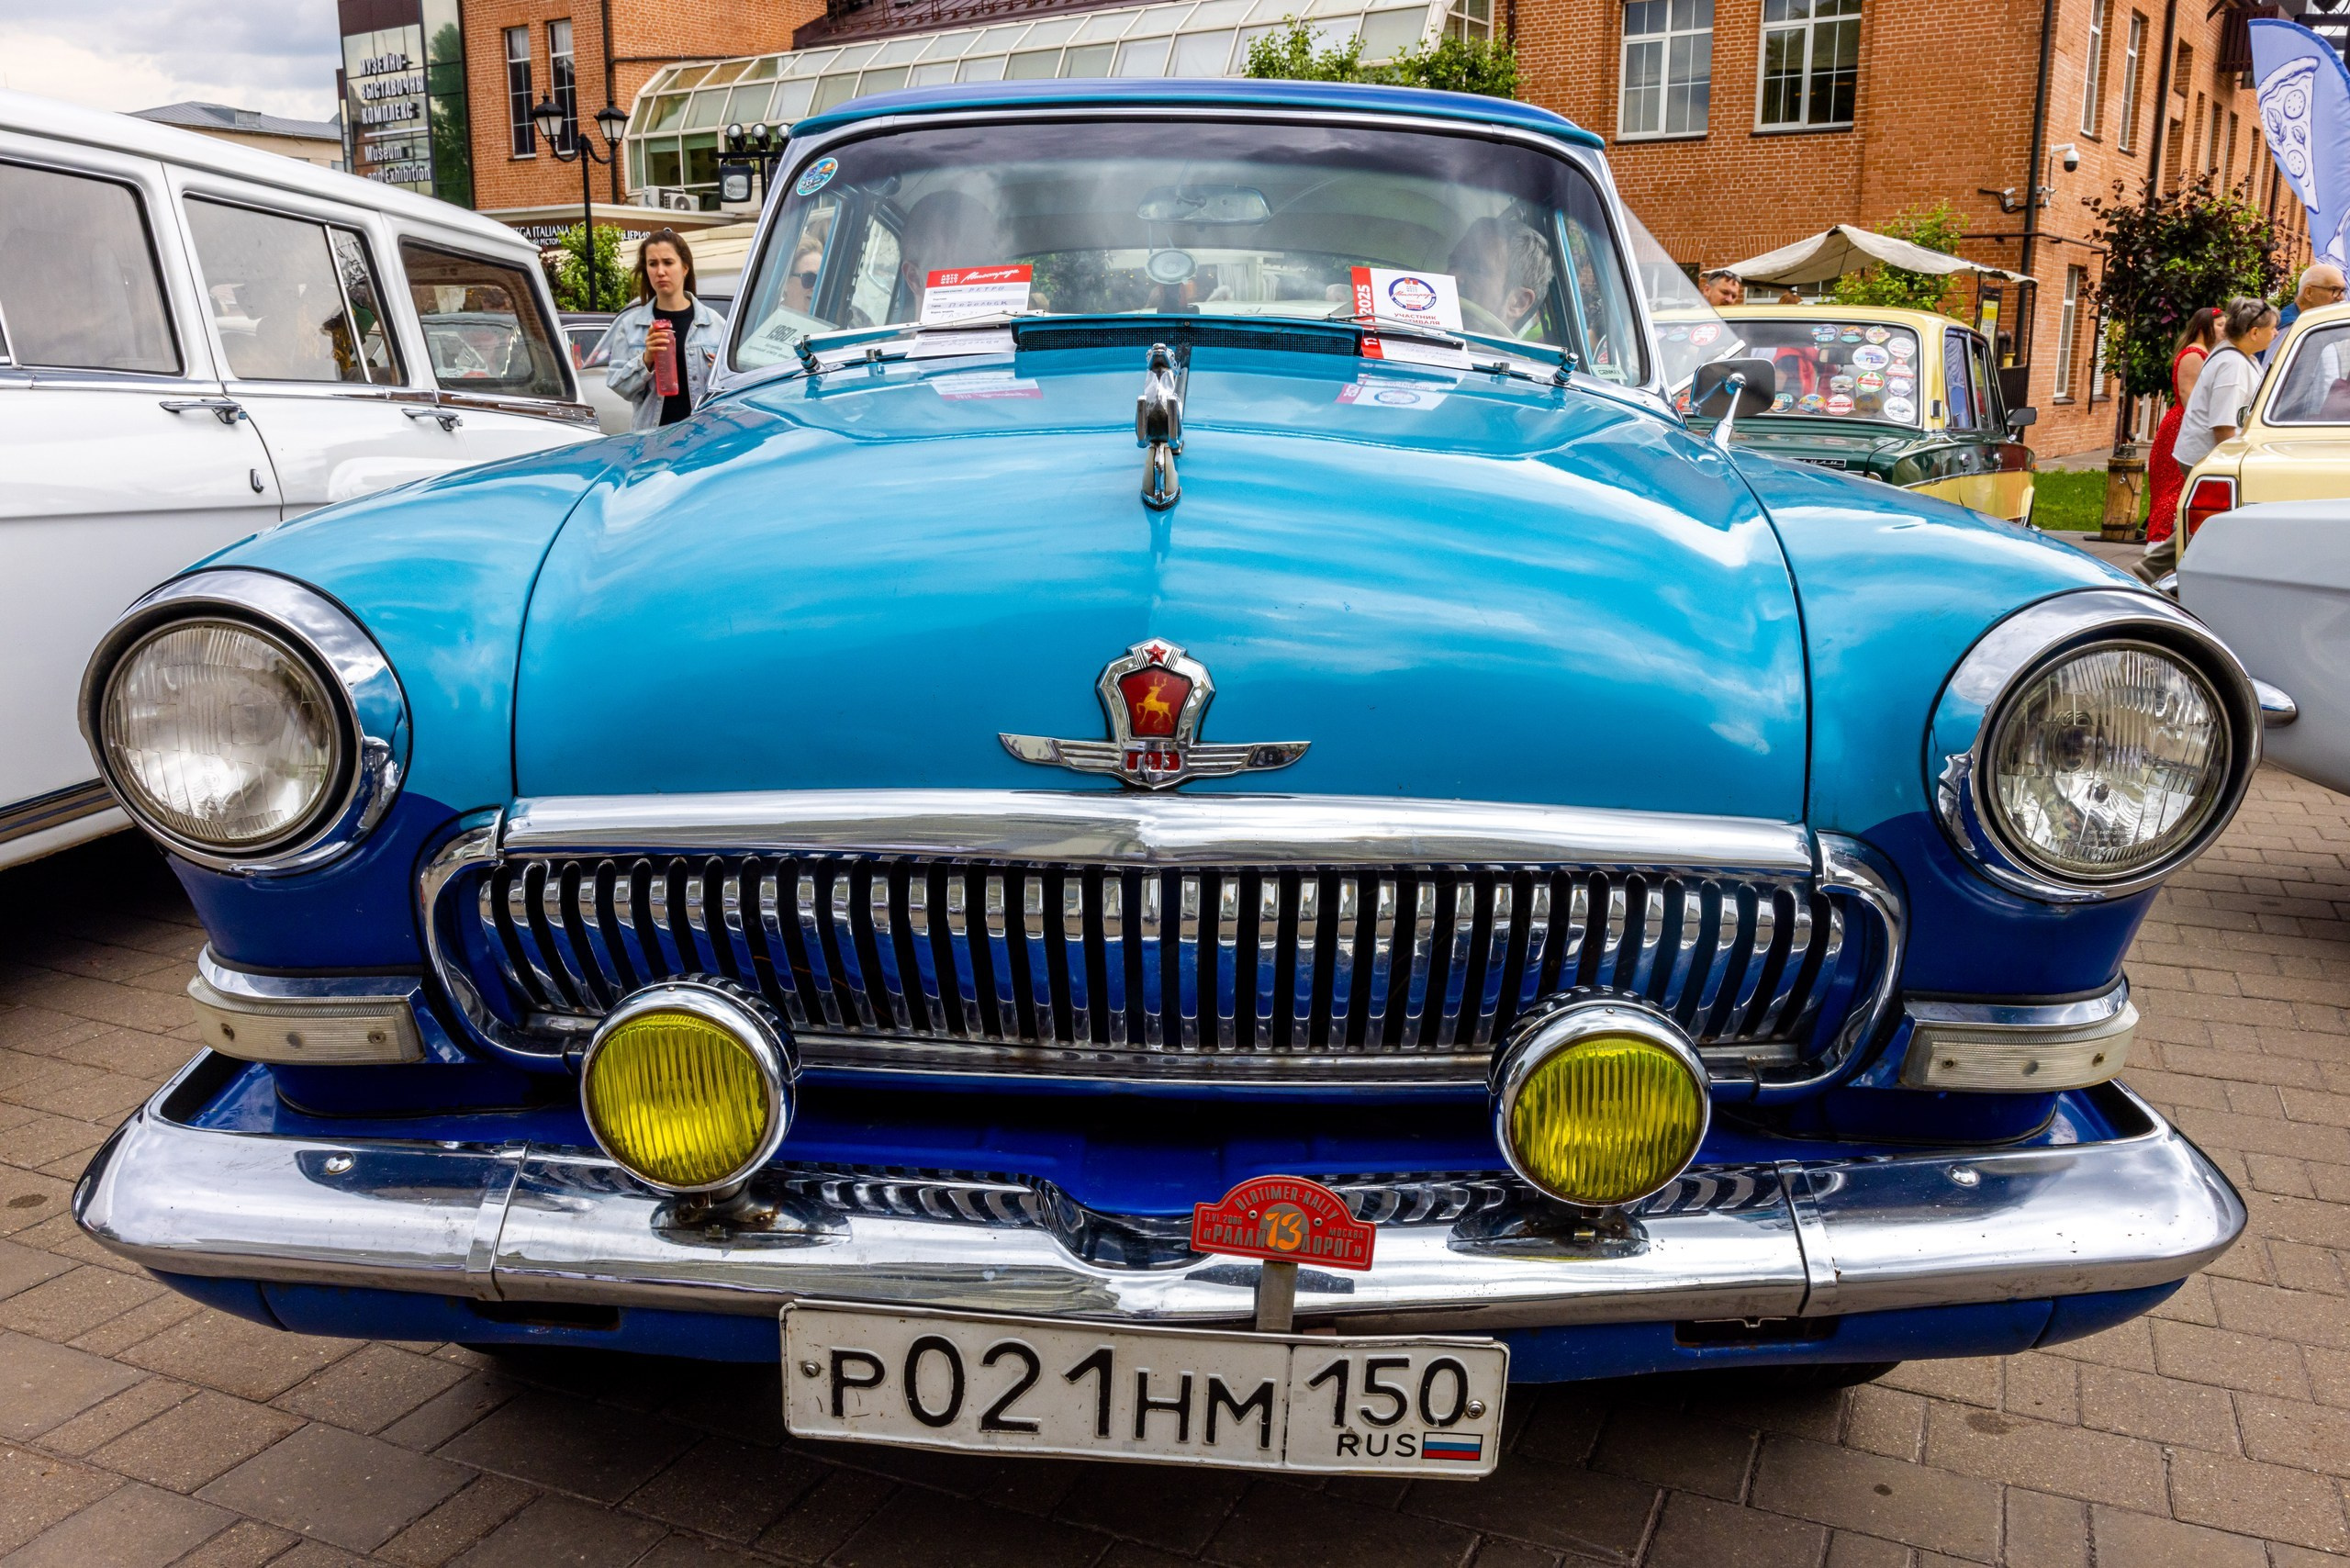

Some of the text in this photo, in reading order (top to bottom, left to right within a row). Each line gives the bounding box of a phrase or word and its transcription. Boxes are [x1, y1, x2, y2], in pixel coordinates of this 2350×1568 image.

[361, 75, 424, 100] ВЫСТАВОЧНЫ
[362, 102, 413, 125] КОМПЛЕКС
[364, 145, 403, 162] Museum
[385, 165, 431, 184] Exhibition
[1356, 284, 1372, 316] 2025
[1393, 312, 1437, 320] УЧАСТНИК
[767, 323, 798, 342] 1960
[1234, 1185, 1340, 1221] OLDTIMER-RALLY
[1203, 1211, 1362, 1258] «РАЛЛИ 13 ДОРОГ»
[1328, 1226, 1364, 1239] МОСКВА
[1304, 1354, 1470, 1429] 150
[1336, 1431, 1418, 1459] RUS
